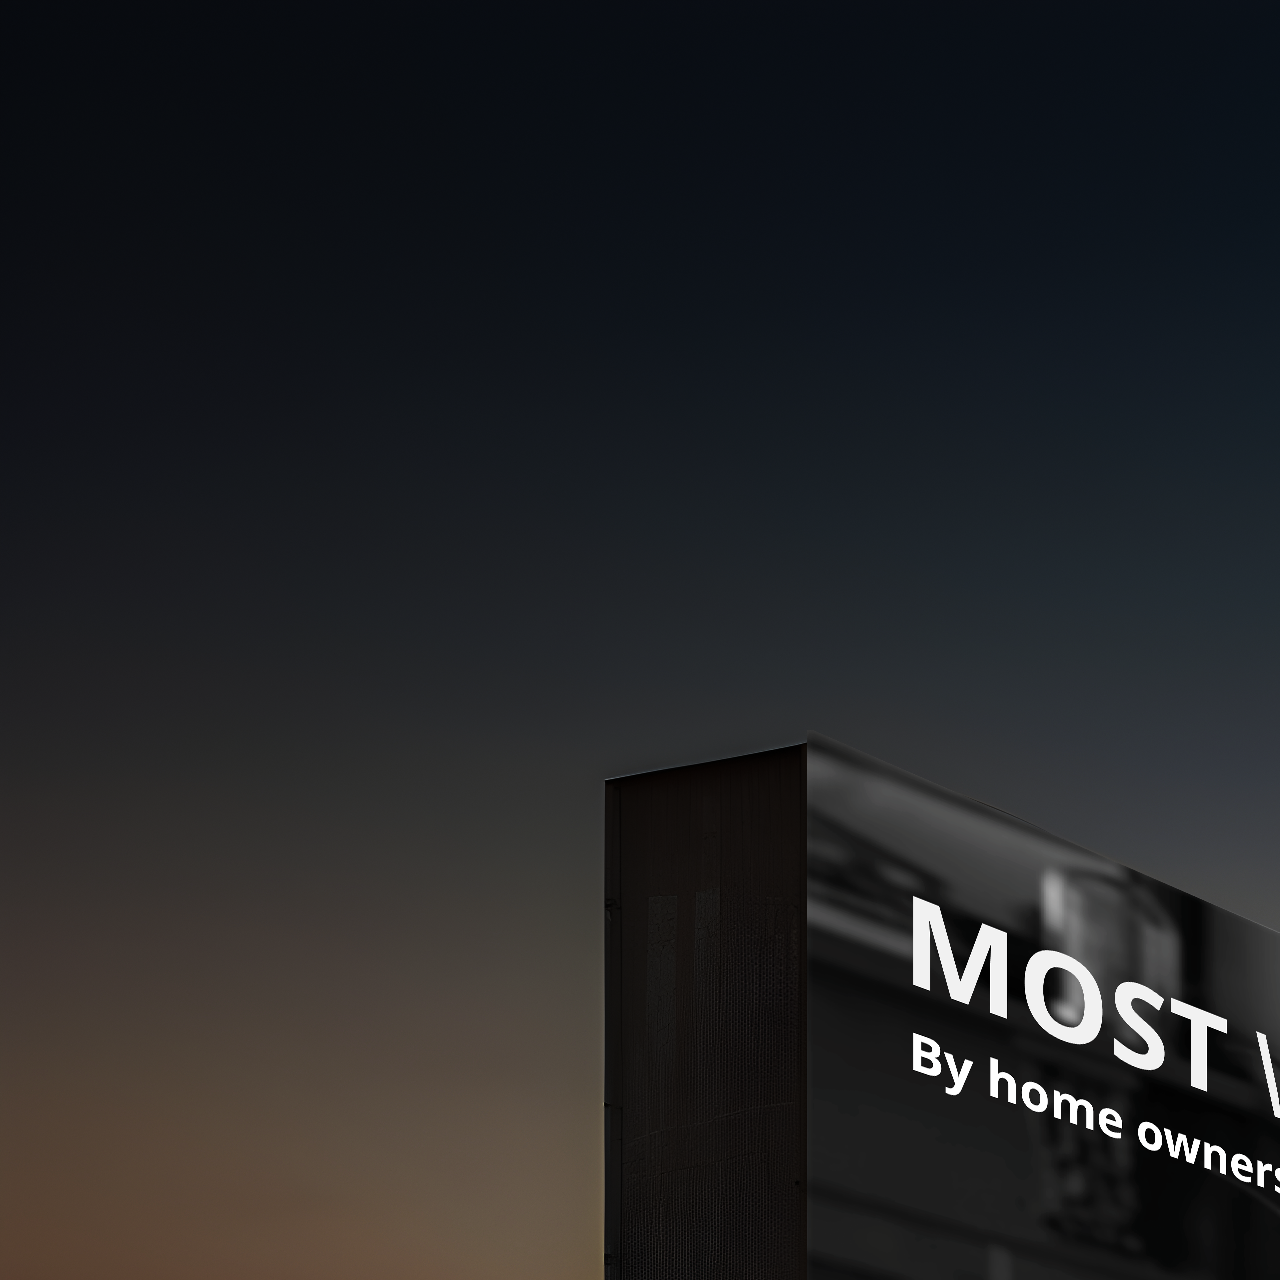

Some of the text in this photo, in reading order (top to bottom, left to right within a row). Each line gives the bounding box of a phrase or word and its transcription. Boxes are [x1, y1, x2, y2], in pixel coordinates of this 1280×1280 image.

[912, 895, 1228, 1092] MOST
[912, 1032, 974, 1096] By
[990, 1057, 1123, 1139] home
